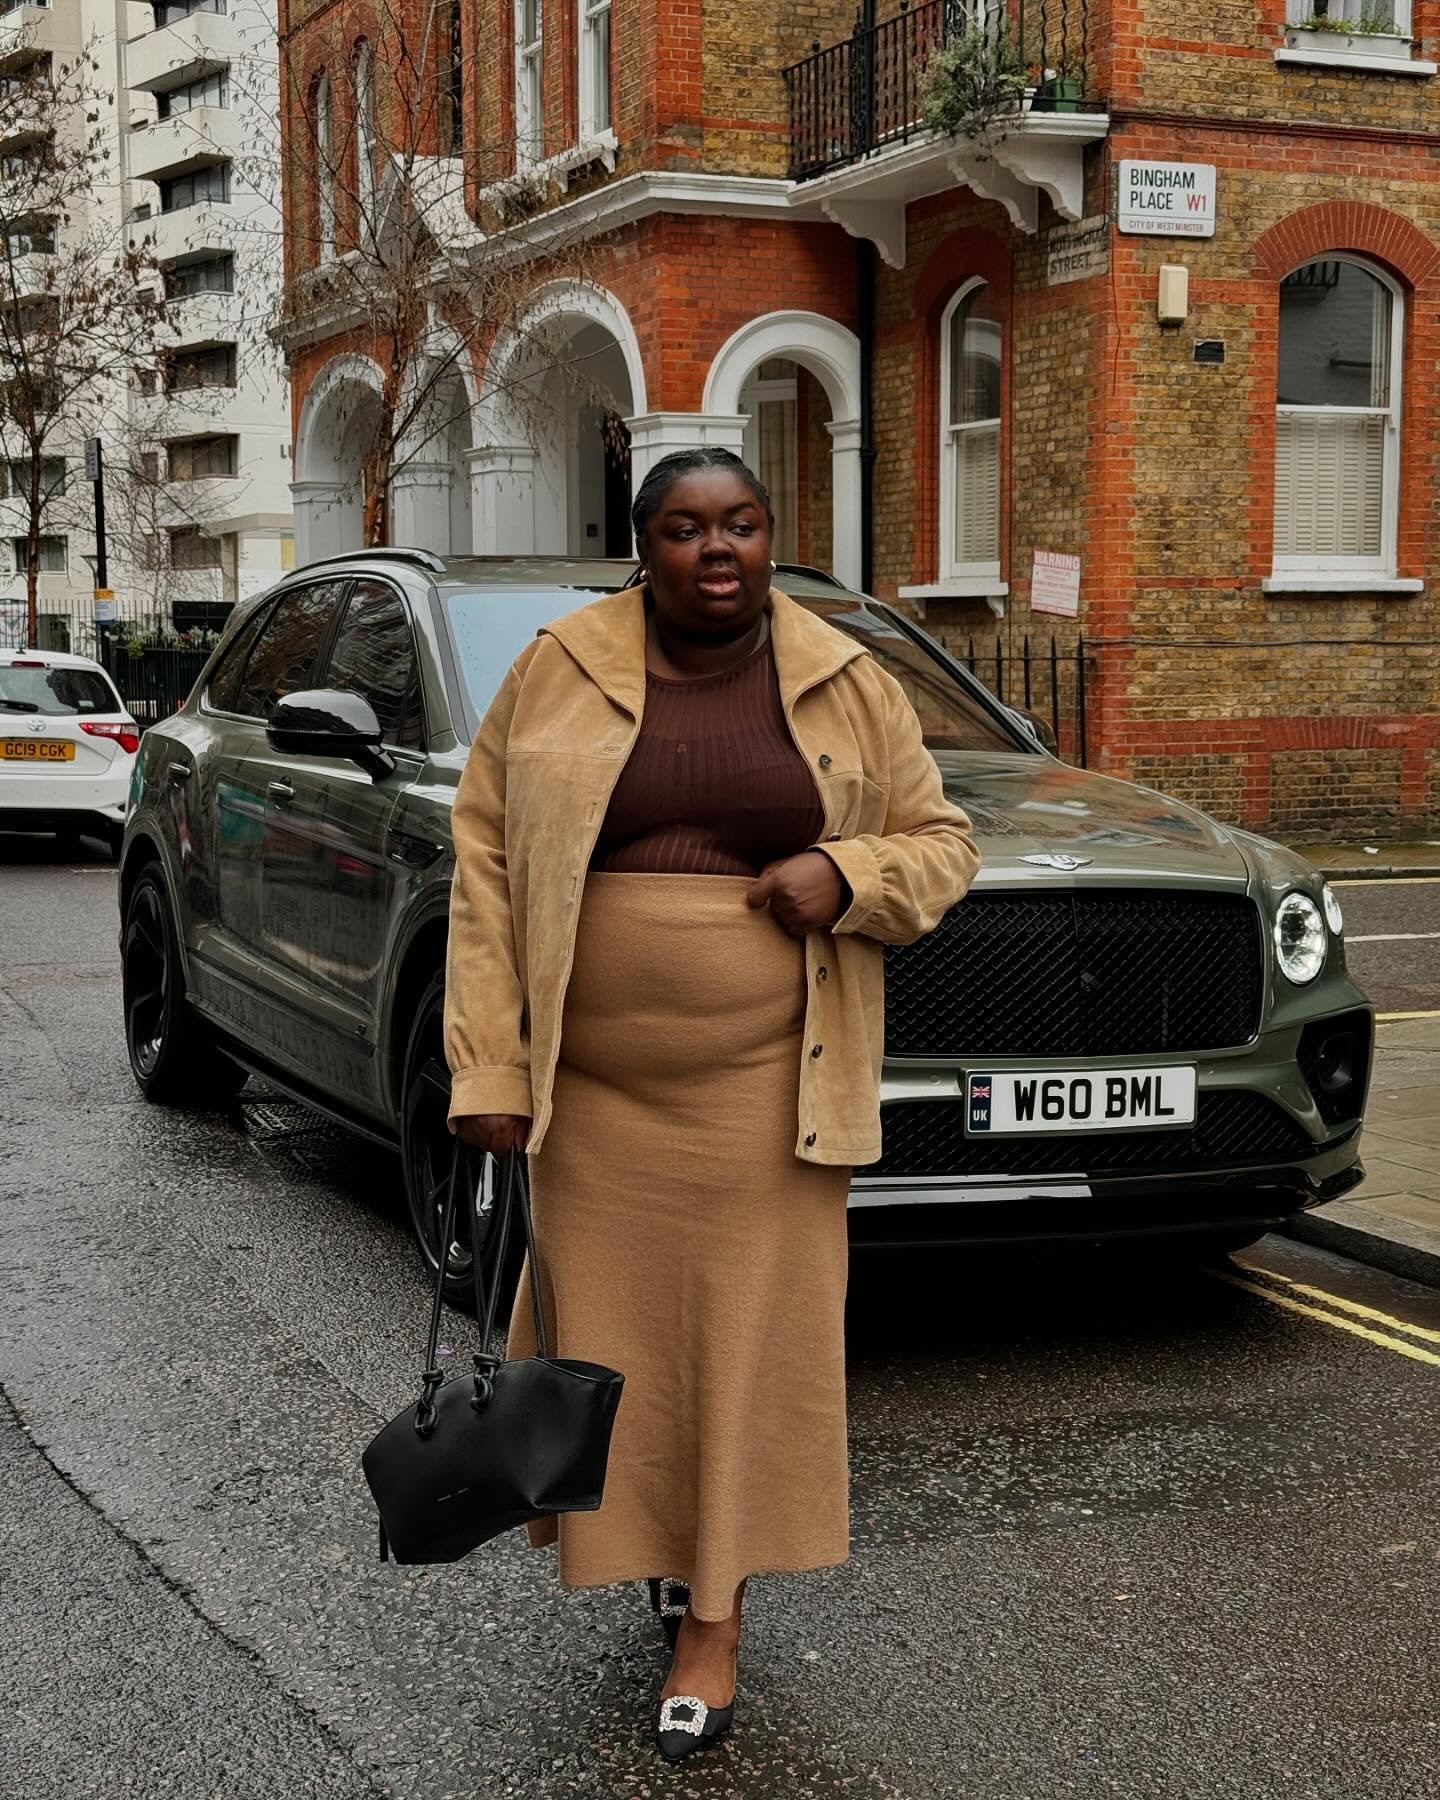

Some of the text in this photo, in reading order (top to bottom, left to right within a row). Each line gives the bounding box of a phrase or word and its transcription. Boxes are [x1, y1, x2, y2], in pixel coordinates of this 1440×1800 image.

[1130, 168, 1195, 189] BINGHAM
[1130, 190, 1207, 212] PLACE W1
[1129, 220, 1205, 233] CITY OF WESTMINSTER
[1034, 551, 1080, 571] WARNING
[5, 742, 67, 757] GC19 CGK
[1013, 1075, 1175, 1122] W60 BML
[973, 1109, 988, 1121] UK
